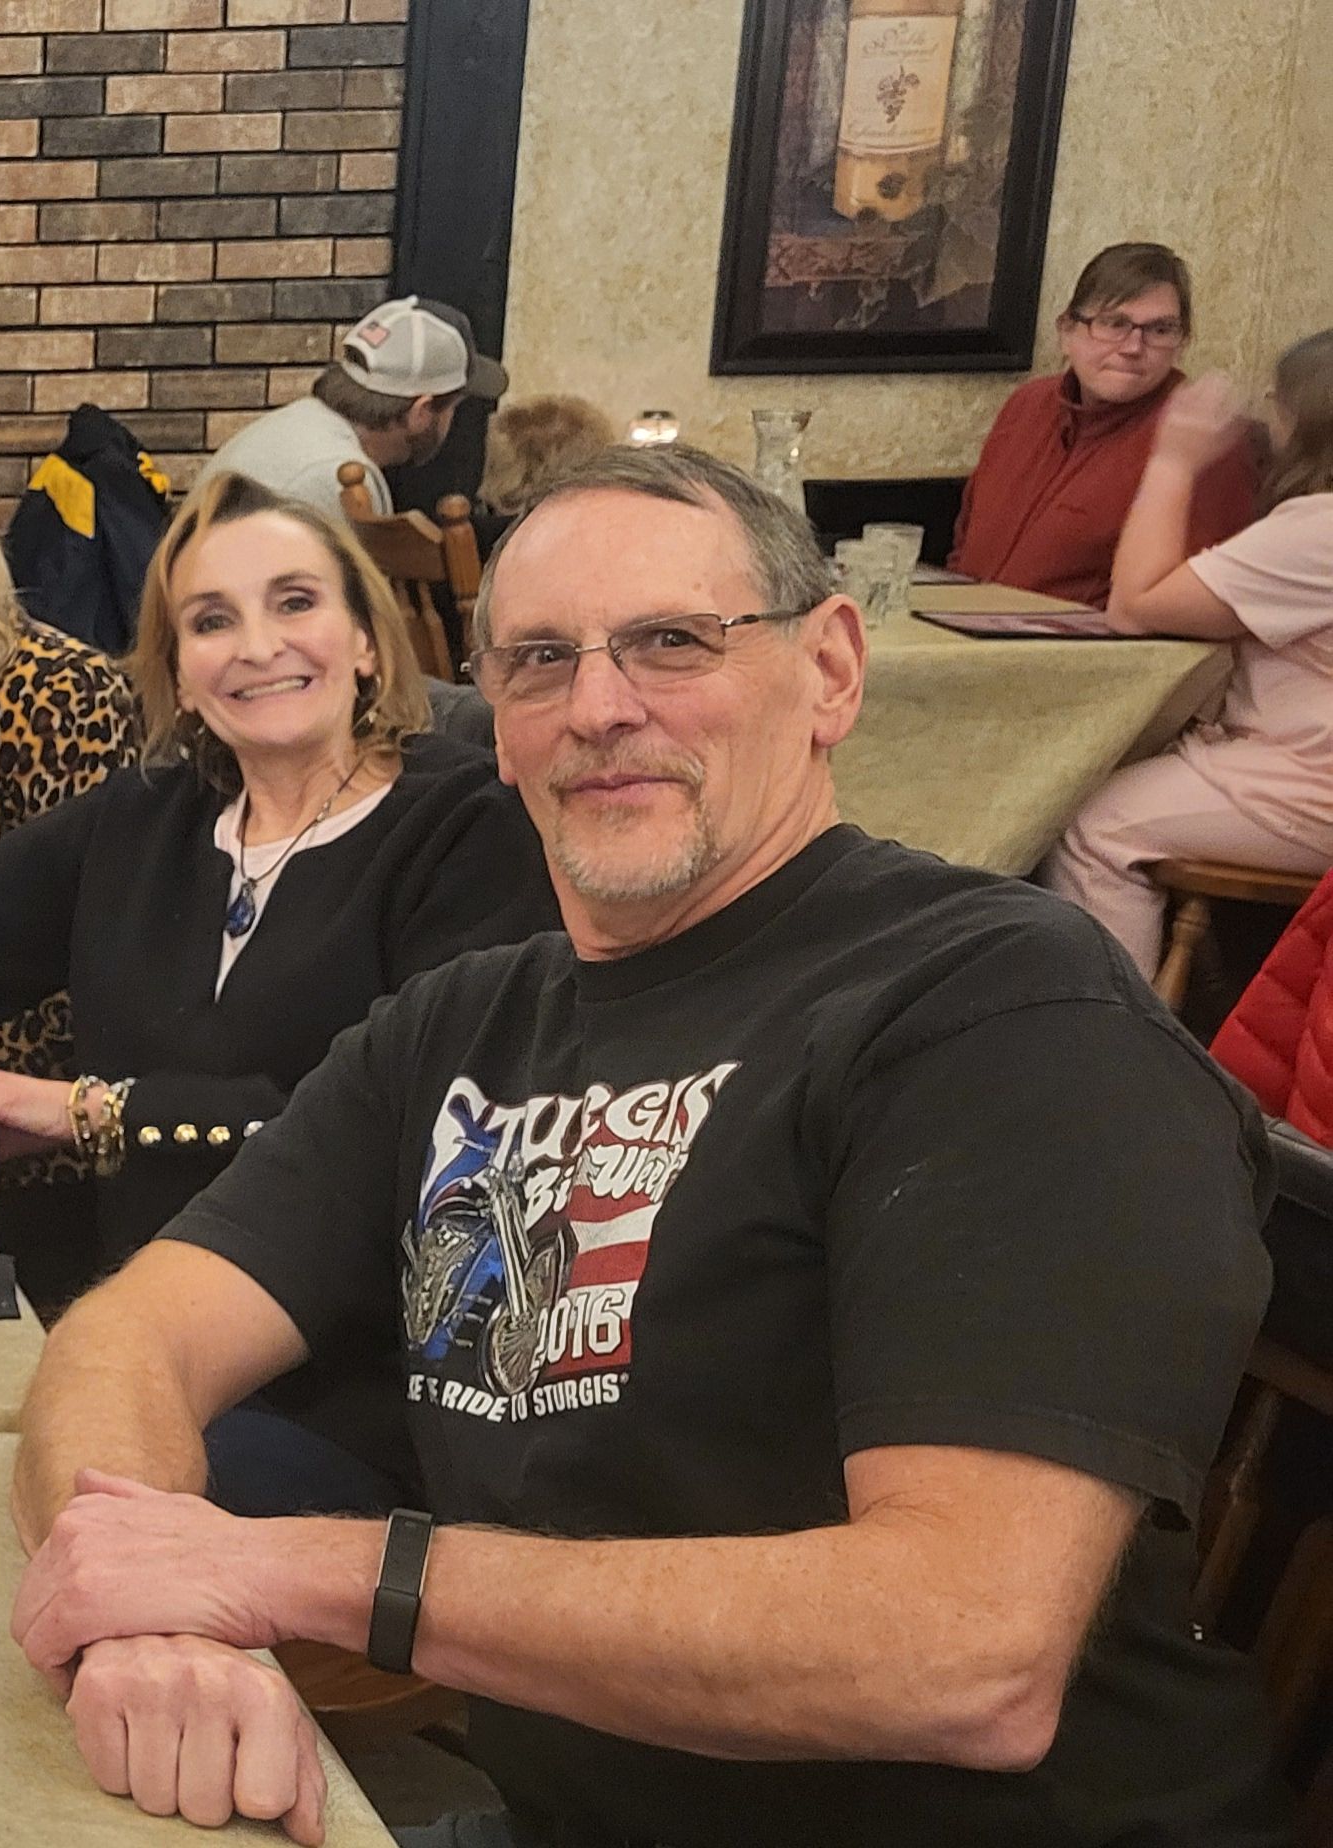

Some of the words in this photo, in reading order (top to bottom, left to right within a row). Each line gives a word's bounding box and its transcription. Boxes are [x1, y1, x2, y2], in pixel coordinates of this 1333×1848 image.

[524, 1165, 576, 1233] Bi
[529, 1288, 625, 1364] 2016
[441, 1380, 510, 1423] RIDE
